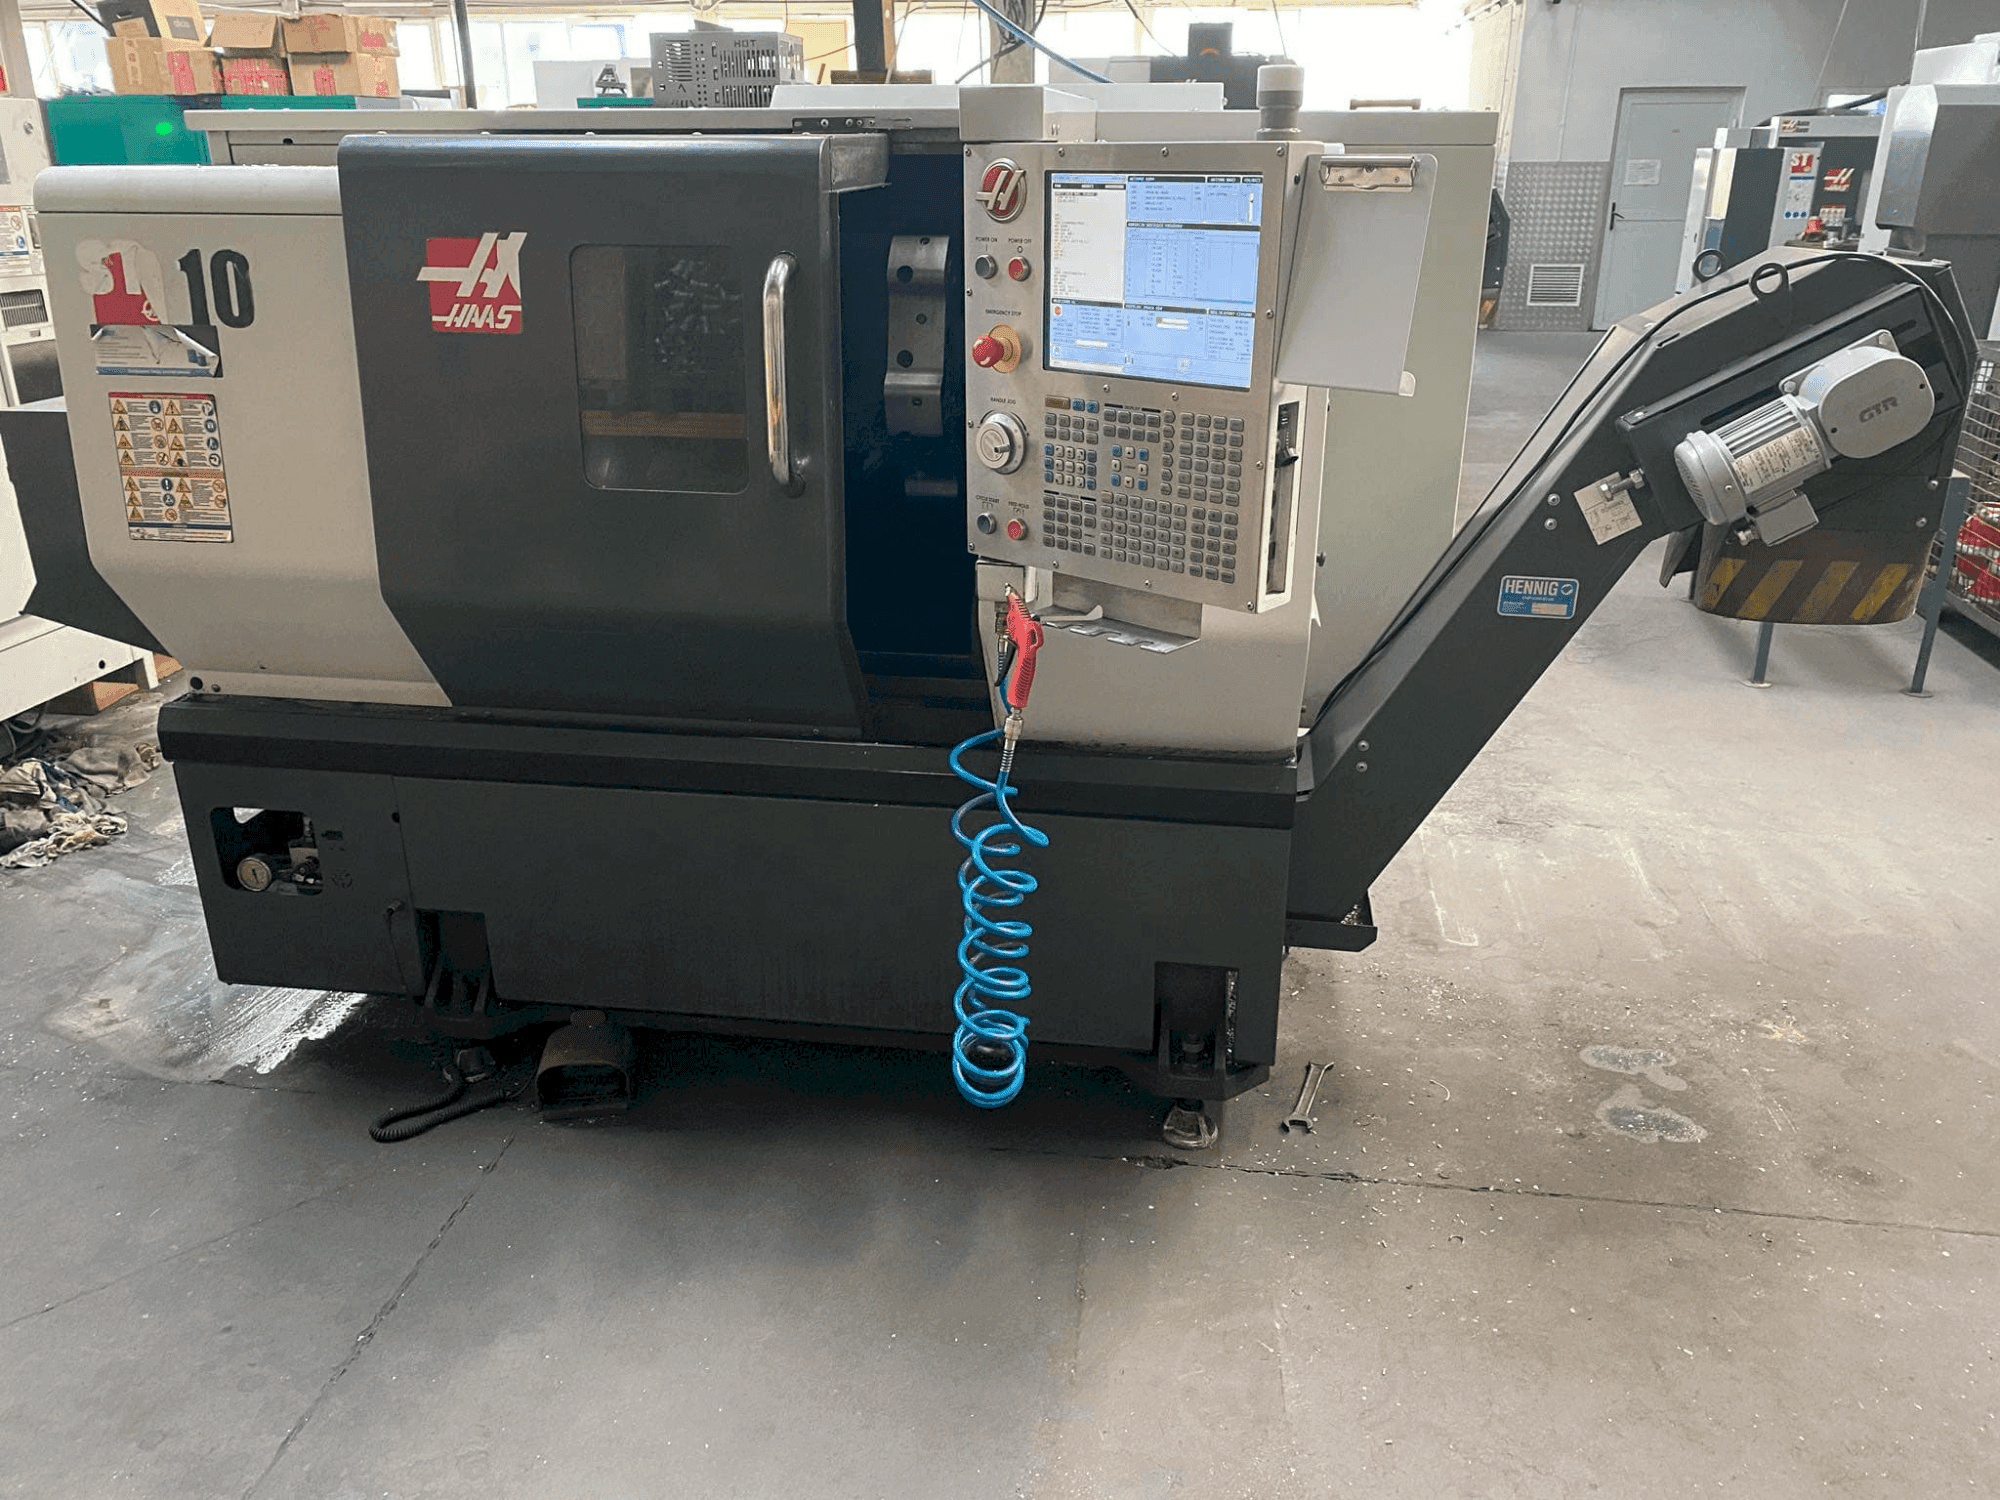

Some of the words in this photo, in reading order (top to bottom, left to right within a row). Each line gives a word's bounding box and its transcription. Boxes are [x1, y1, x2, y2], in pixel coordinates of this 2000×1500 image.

[1789, 152, 1811, 167] ST
[178, 248, 255, 329] 10
[431, 303, 523, 329] HAAS
[1859, 396, 1898, 423] GTR
[1504, 579, 1559, 597] HENNIG
